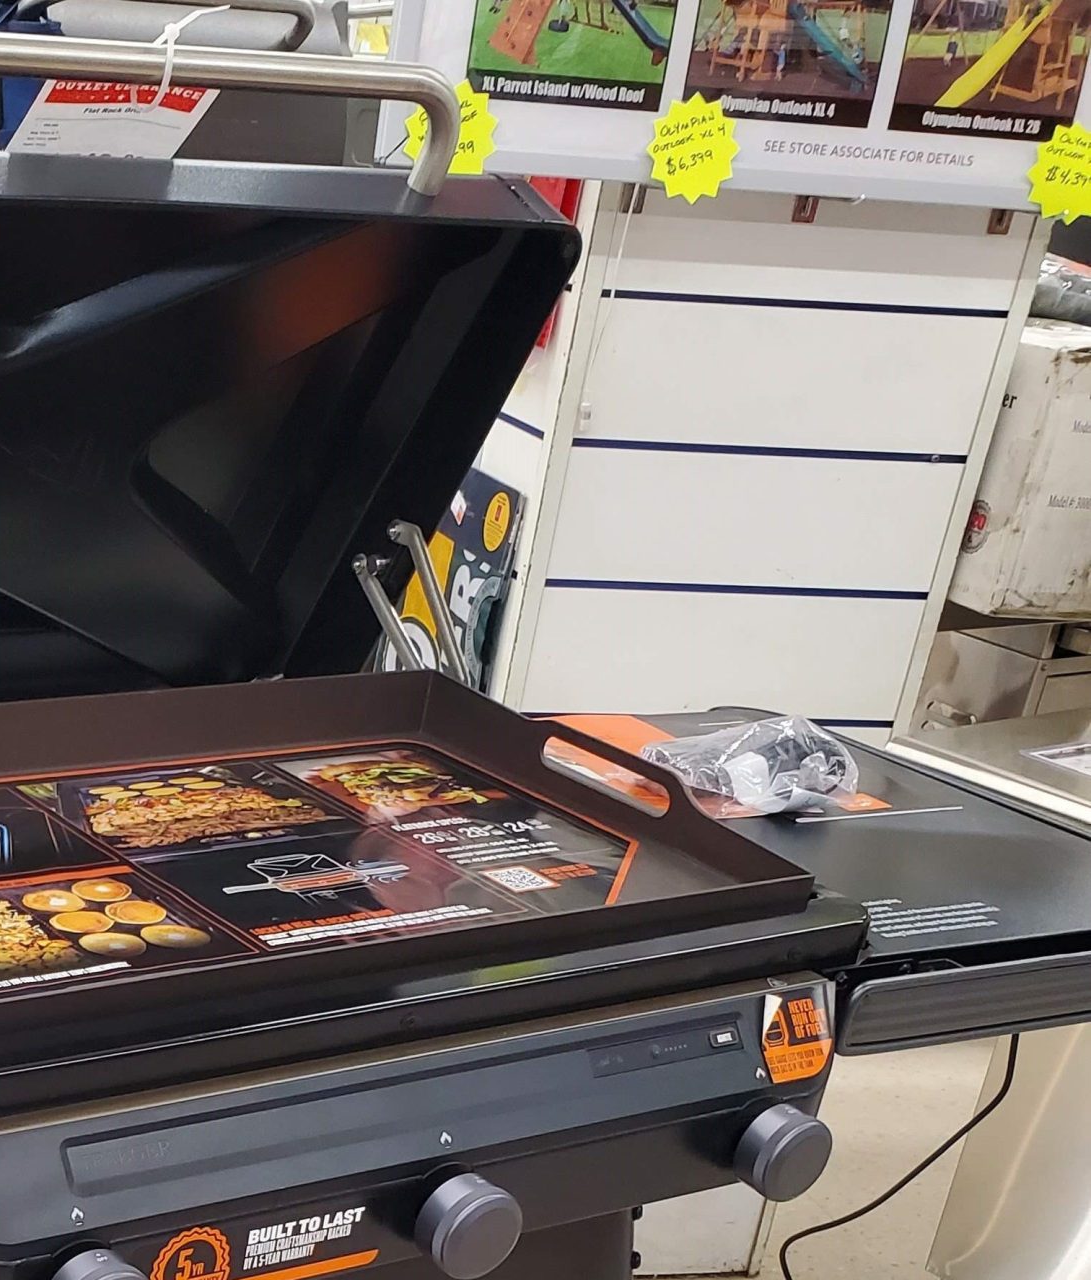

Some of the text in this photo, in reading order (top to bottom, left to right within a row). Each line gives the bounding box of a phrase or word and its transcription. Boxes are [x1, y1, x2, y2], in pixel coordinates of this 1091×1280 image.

[54, 81, 203, 100] OUTLET CLARNCE
[481, 75, 646, 103] XL Parrot Island w/Wood Roof
[720, 94, 836, 118] Olympian Outlook XL 4
[659, 111, 716, 137] OLYMPIAN
[921, 110, 973, 130] Olympian
[972, 115, 1013, 132] Outlook
[1012, 118, 1026, 133] XL
[652, 123, 727, 154] OUTLOOK XL 4
[665, 150, 714, 177] $6,399
[763, 139, 975, 167] SEE STORE ASSOCIATE FOR DETAILS
[1044, 165, 1091, 189] $4,39
[503, 821, 534, 833] 24
[787, 998, 815, 1014] NEVER
[790, 1008, 828, 1026] RUN OUT
[793, 1021, 829, 1039] OF FUEL
[247, 1207, 366, 1245] BUILT TO LAST
[245, 1224, 352, 1258] PREMIUM CRAFTSMANSHIP BACKED
[192, 1262, 205, 1277] YR
[242, 1244, 315, 1271] BY A 5-YEAR WARRANTY
